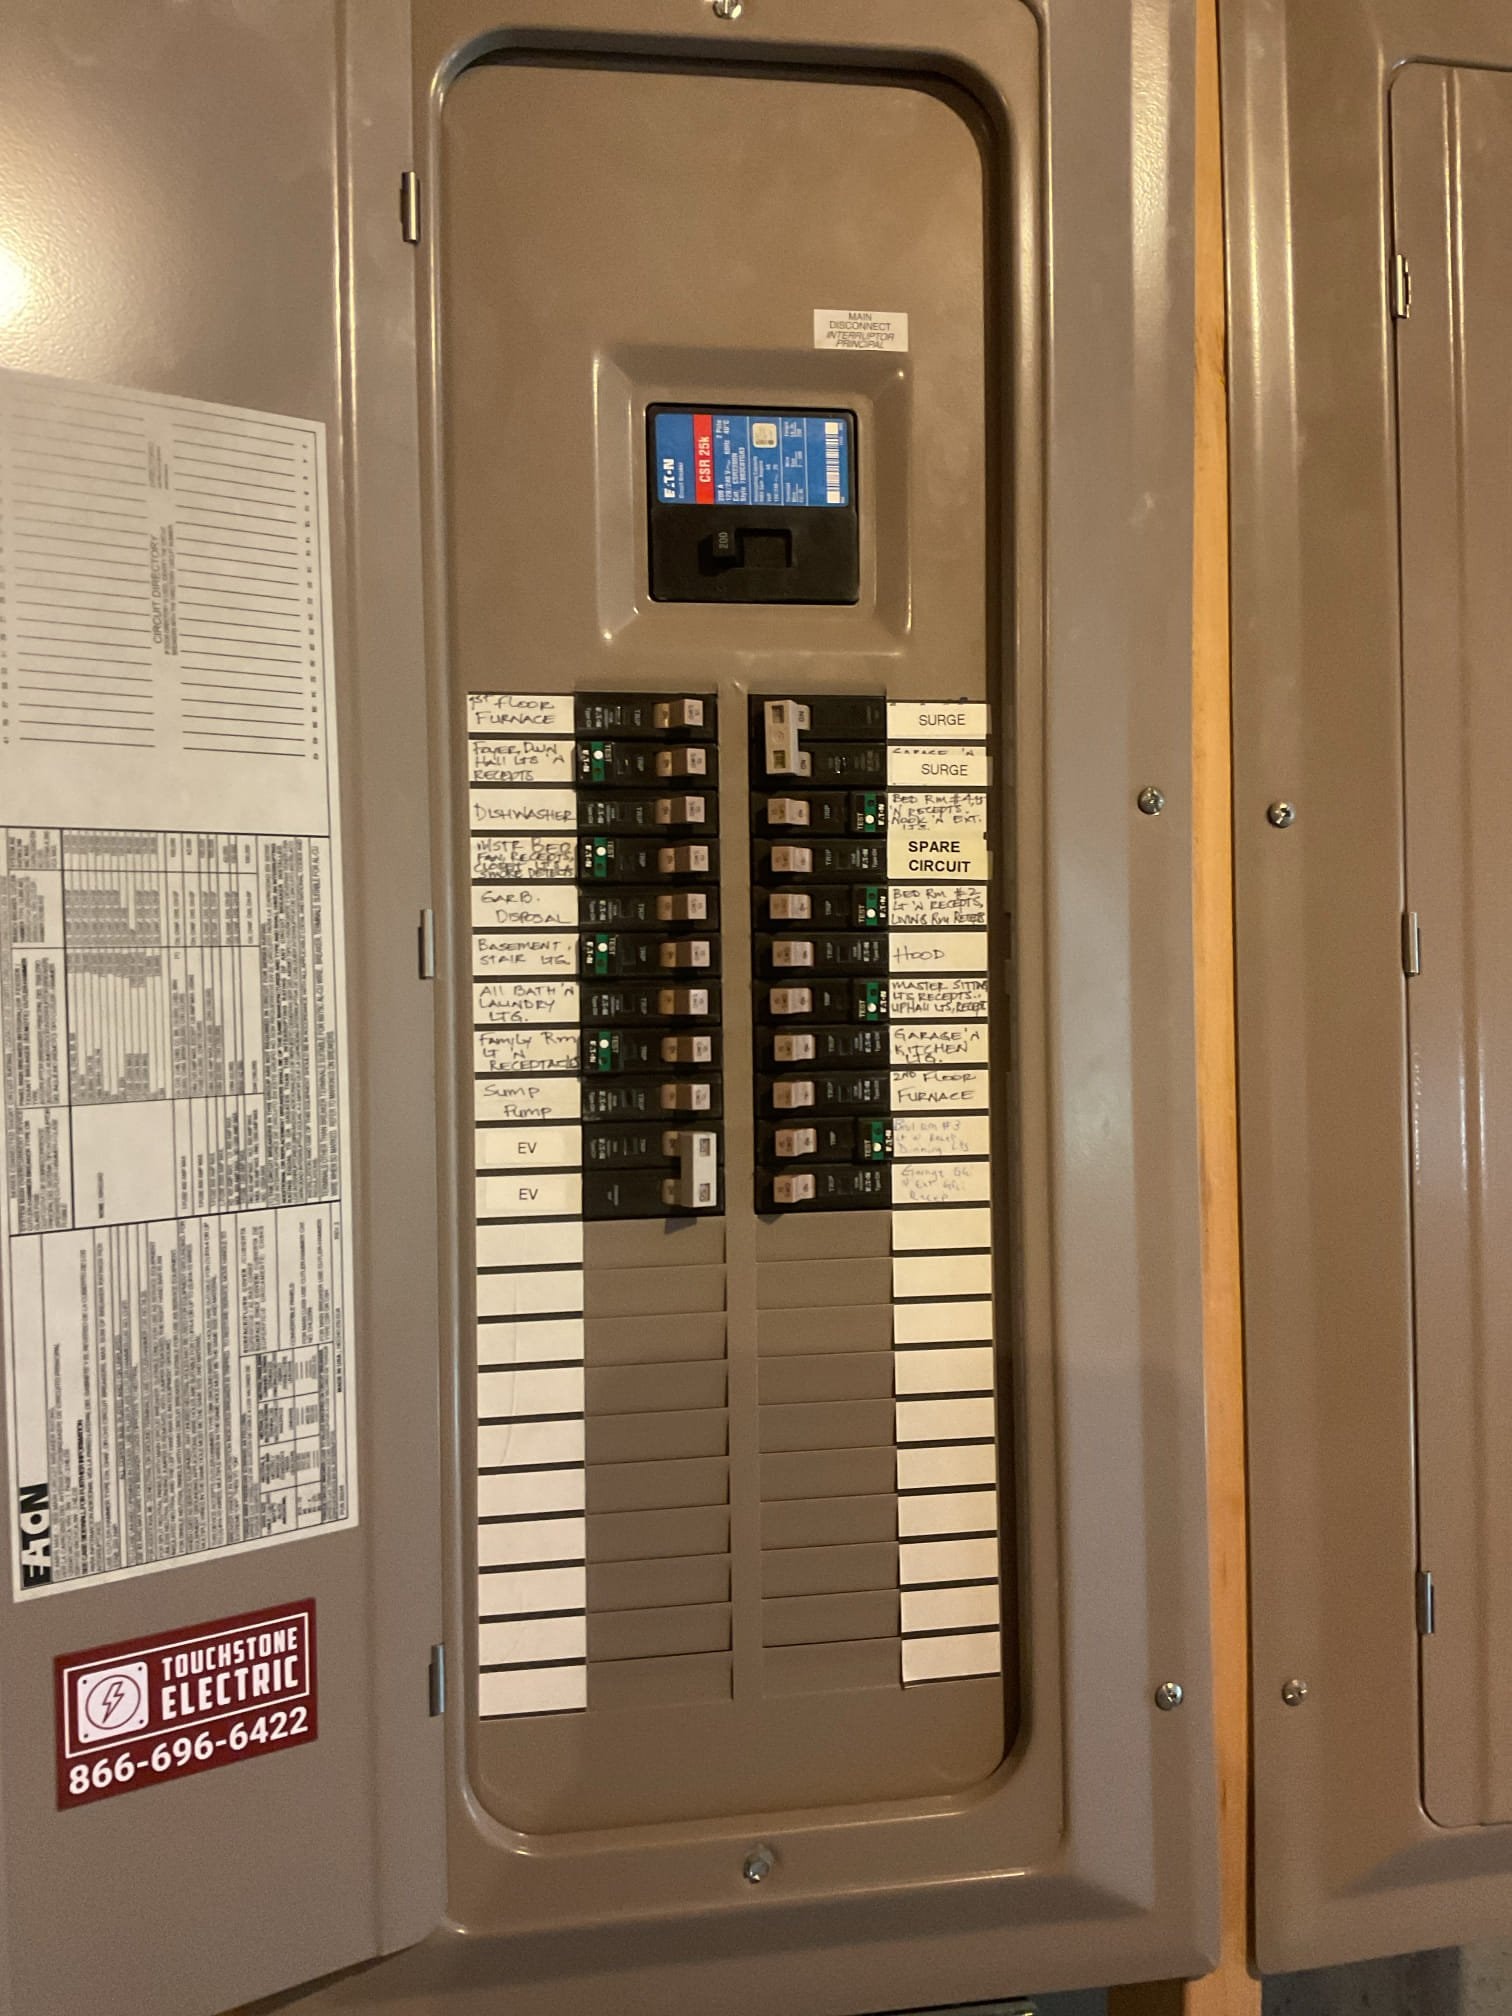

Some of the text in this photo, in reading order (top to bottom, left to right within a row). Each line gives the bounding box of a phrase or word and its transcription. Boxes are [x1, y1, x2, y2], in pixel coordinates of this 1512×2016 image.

[830, 321, 890, 330] DISCONNECT
[827, 331, 894, 341] INTERRUPTOR
[837, 340, 884, 348] PRINCIPAL
[698, 436, 711, 483] CSR 25k
[663, 459, 675, 498] EATON
[150, 534, 162, 643] CIRCUIT DIRECTORY
[475, 712, 555, 724] FURNACE
[799, 711, 804, 721] ON
[919, 714, 966, 726] SURGE
[801, 760, 806, 769] ON
[921, 764, 968, 776] SURGE
[474, 803, 576, 823] DISHWASHER
[908, 841, 960, 853] SPARE
[909, 860, 971, 872] CIRCUIT
[496, 909, 572, 924] DISPOSAL
[480, 955, 526, 965] STAIR
[893, 945, 945, 964] HOOD
[513, 985, 556, 997] BATH
[479, 999, 555, 1012] LAUNDRY
[894, 1029, 961, 1041] GARAGE
[898, 1087, 976, 1103] FURNACE
[518, 1143, 538, 1154] EV
[519, 1189, 538, 1200] EV
[18, 1483, 51, 1587] EATON
[161, 1627, 298, 1681] TOUCHSTONE
[161, 1655, 298, 1720] ELECTRIC
[69, 1706, 308, 1794] 866-696-6422
